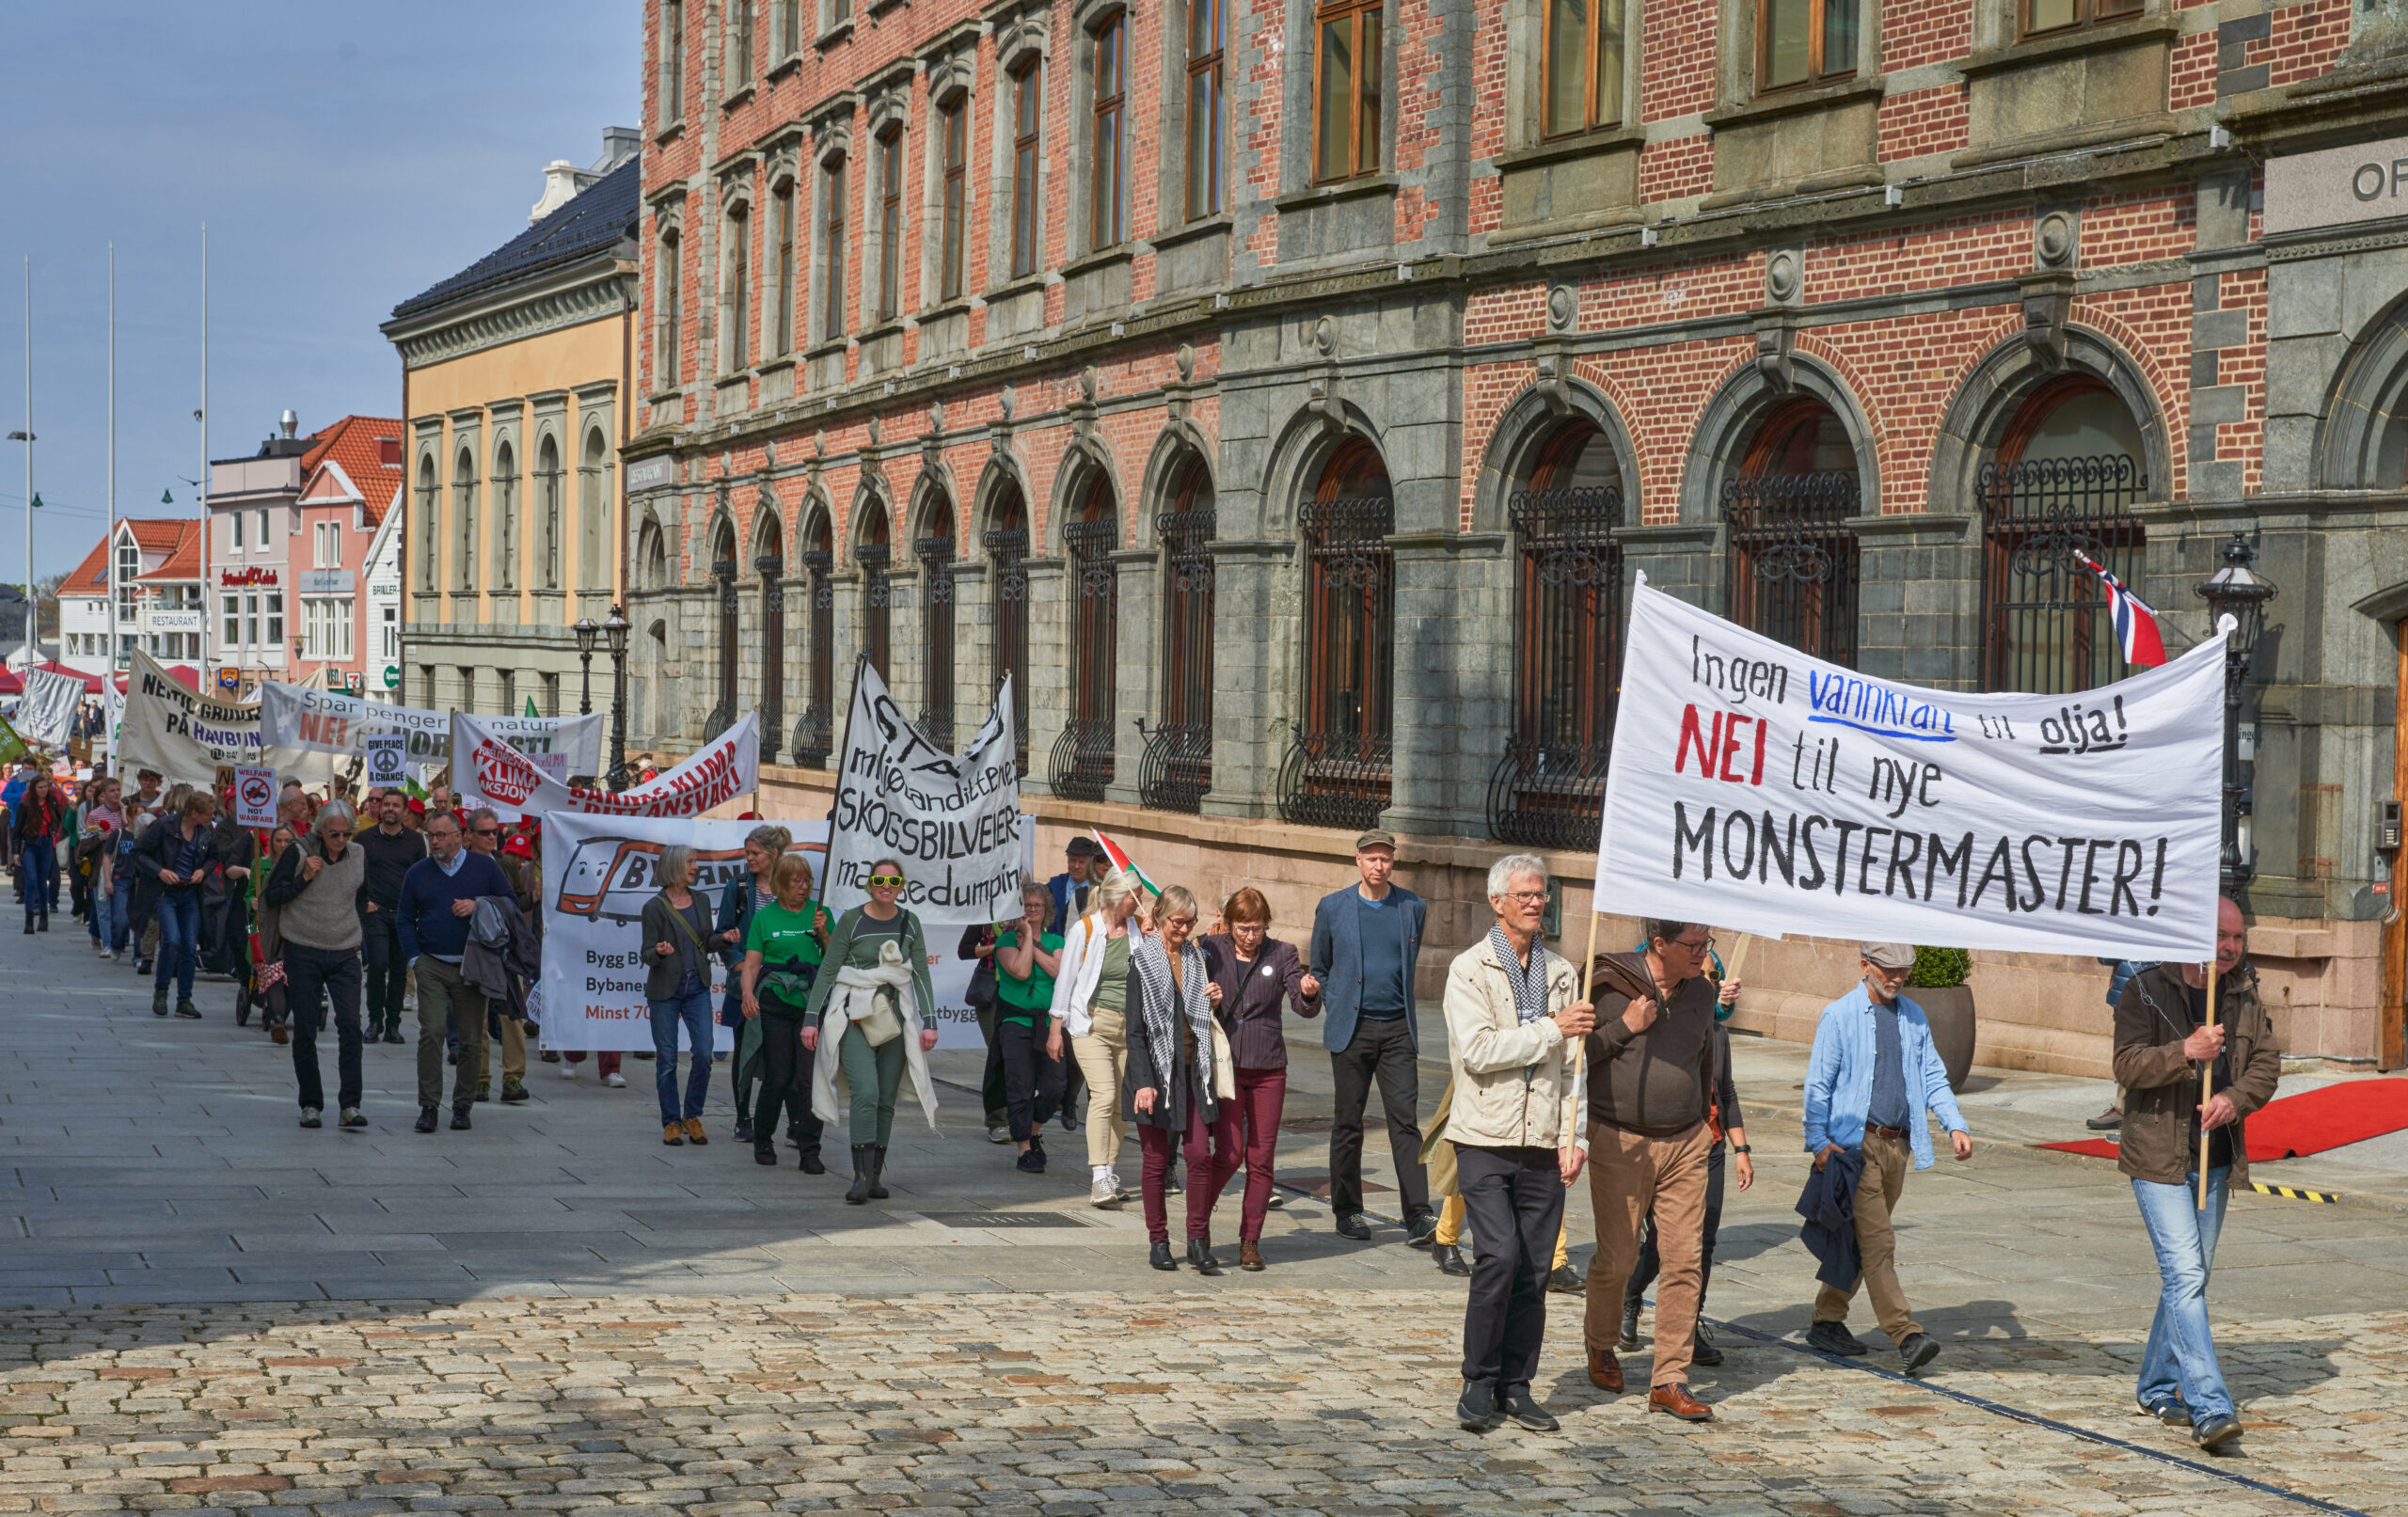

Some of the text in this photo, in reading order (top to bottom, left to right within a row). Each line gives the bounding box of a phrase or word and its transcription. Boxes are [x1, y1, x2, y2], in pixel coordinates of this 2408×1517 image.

[152, 616, 197, 625] RESTAURANT
[170, 689, 194, 715] TIL
[1693, 634, 1788, 704] Ingen
[1979, 714, 2016, 739] til
[2039, 694, 2128, 754] olja!
[303, 691, 558, 732] Spar penger natur:
[166, 712, 261, 747] PÅ HAVBUN
[298, 713, 349, 747] NEI
[368, 739, 404, 751] GIVE PEACE
[238, 768, 272, 778] WELFARE
[475, 755, 536, 789] KLIMA
[669, 740, 737, 795] KLIMA
[1675, 703, 1942, 818] NEI til nye
[369, 771, 404, 782] A CHANCE
[480, 780, 530, 799] AKSJON
[645, 766, 741, 817] ANSVAR!
[239, 814, 274, 823] WARFARE
[1673, 801, 2168, 917] MONSTERMASTER!
[586, 950, 625, 970] Bygg
[585, 1004, 629, 1019] Minst
